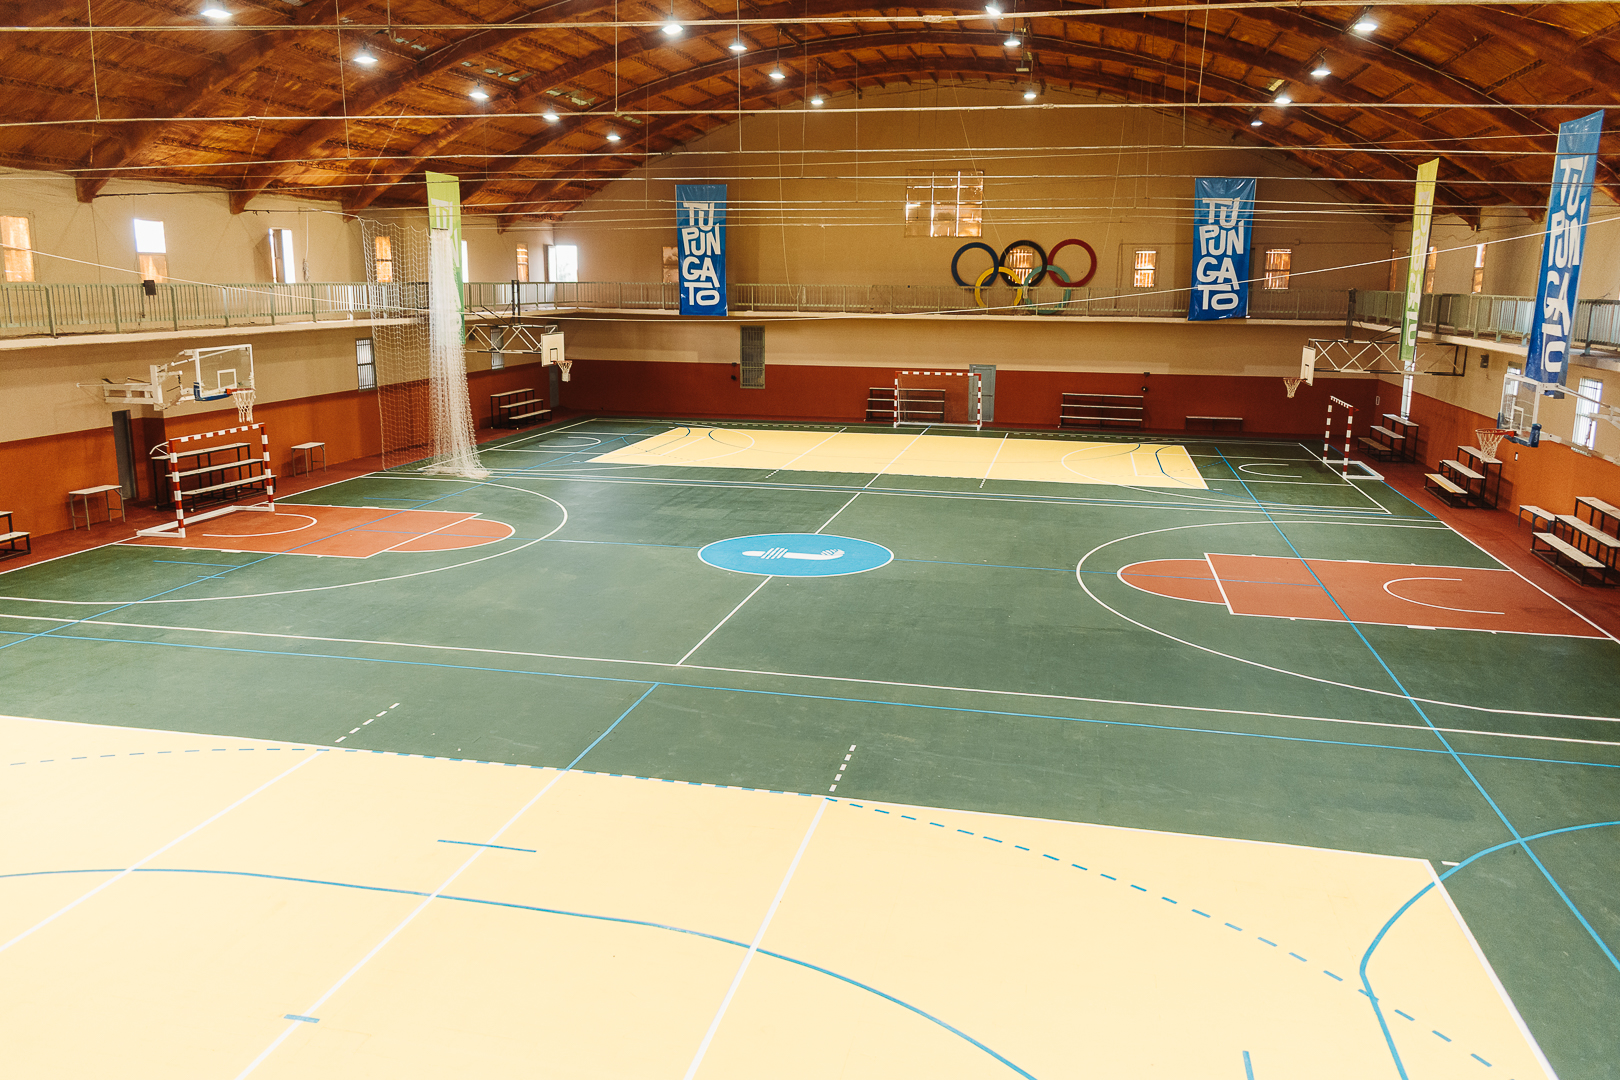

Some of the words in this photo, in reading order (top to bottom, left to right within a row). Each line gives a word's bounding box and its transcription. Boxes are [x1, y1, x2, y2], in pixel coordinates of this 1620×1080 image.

[1560, 155, 1589, 216] TU
[683, 201, 715, 231] TU
[1202, 197, 1240, 229] TU
[681, 223, 721, 256] PUN
[1199, 220, 1245, 256] PUN
[1548, 198, 1587, 269] PUN
[682, 256, 721, 288] GA
[1196, 256, 1241, 291] GA
[683, 281, 721, 306] TO
[1197, 284, 1239, 310] TO
[1543, 270, 1571, 336] GA
